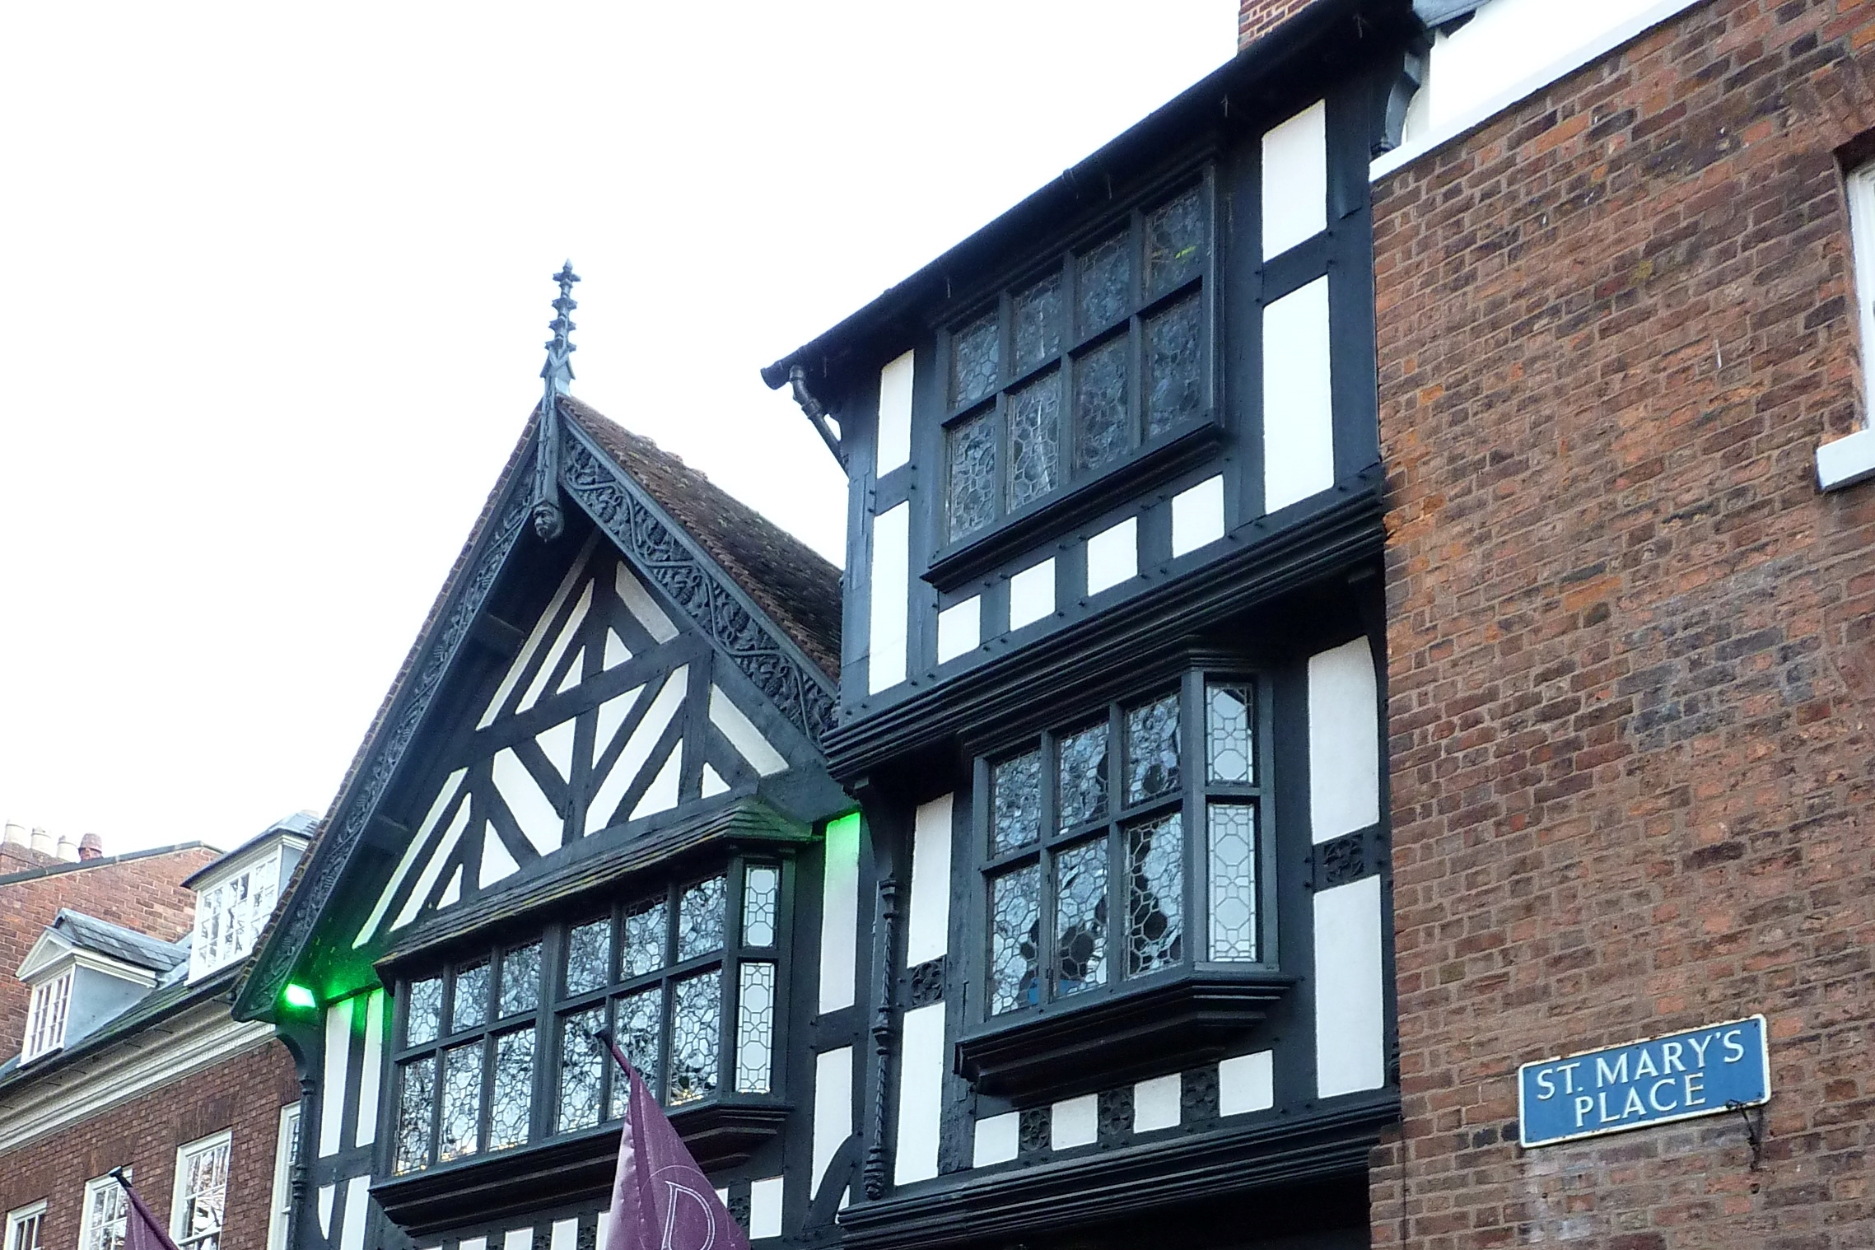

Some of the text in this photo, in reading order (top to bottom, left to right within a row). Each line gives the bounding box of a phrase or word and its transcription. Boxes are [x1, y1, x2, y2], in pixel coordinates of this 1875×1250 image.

[1537, 1030, 1745, 1100] ST. MARY'S
[1575, 1072, 1705, 1127] PLACE
